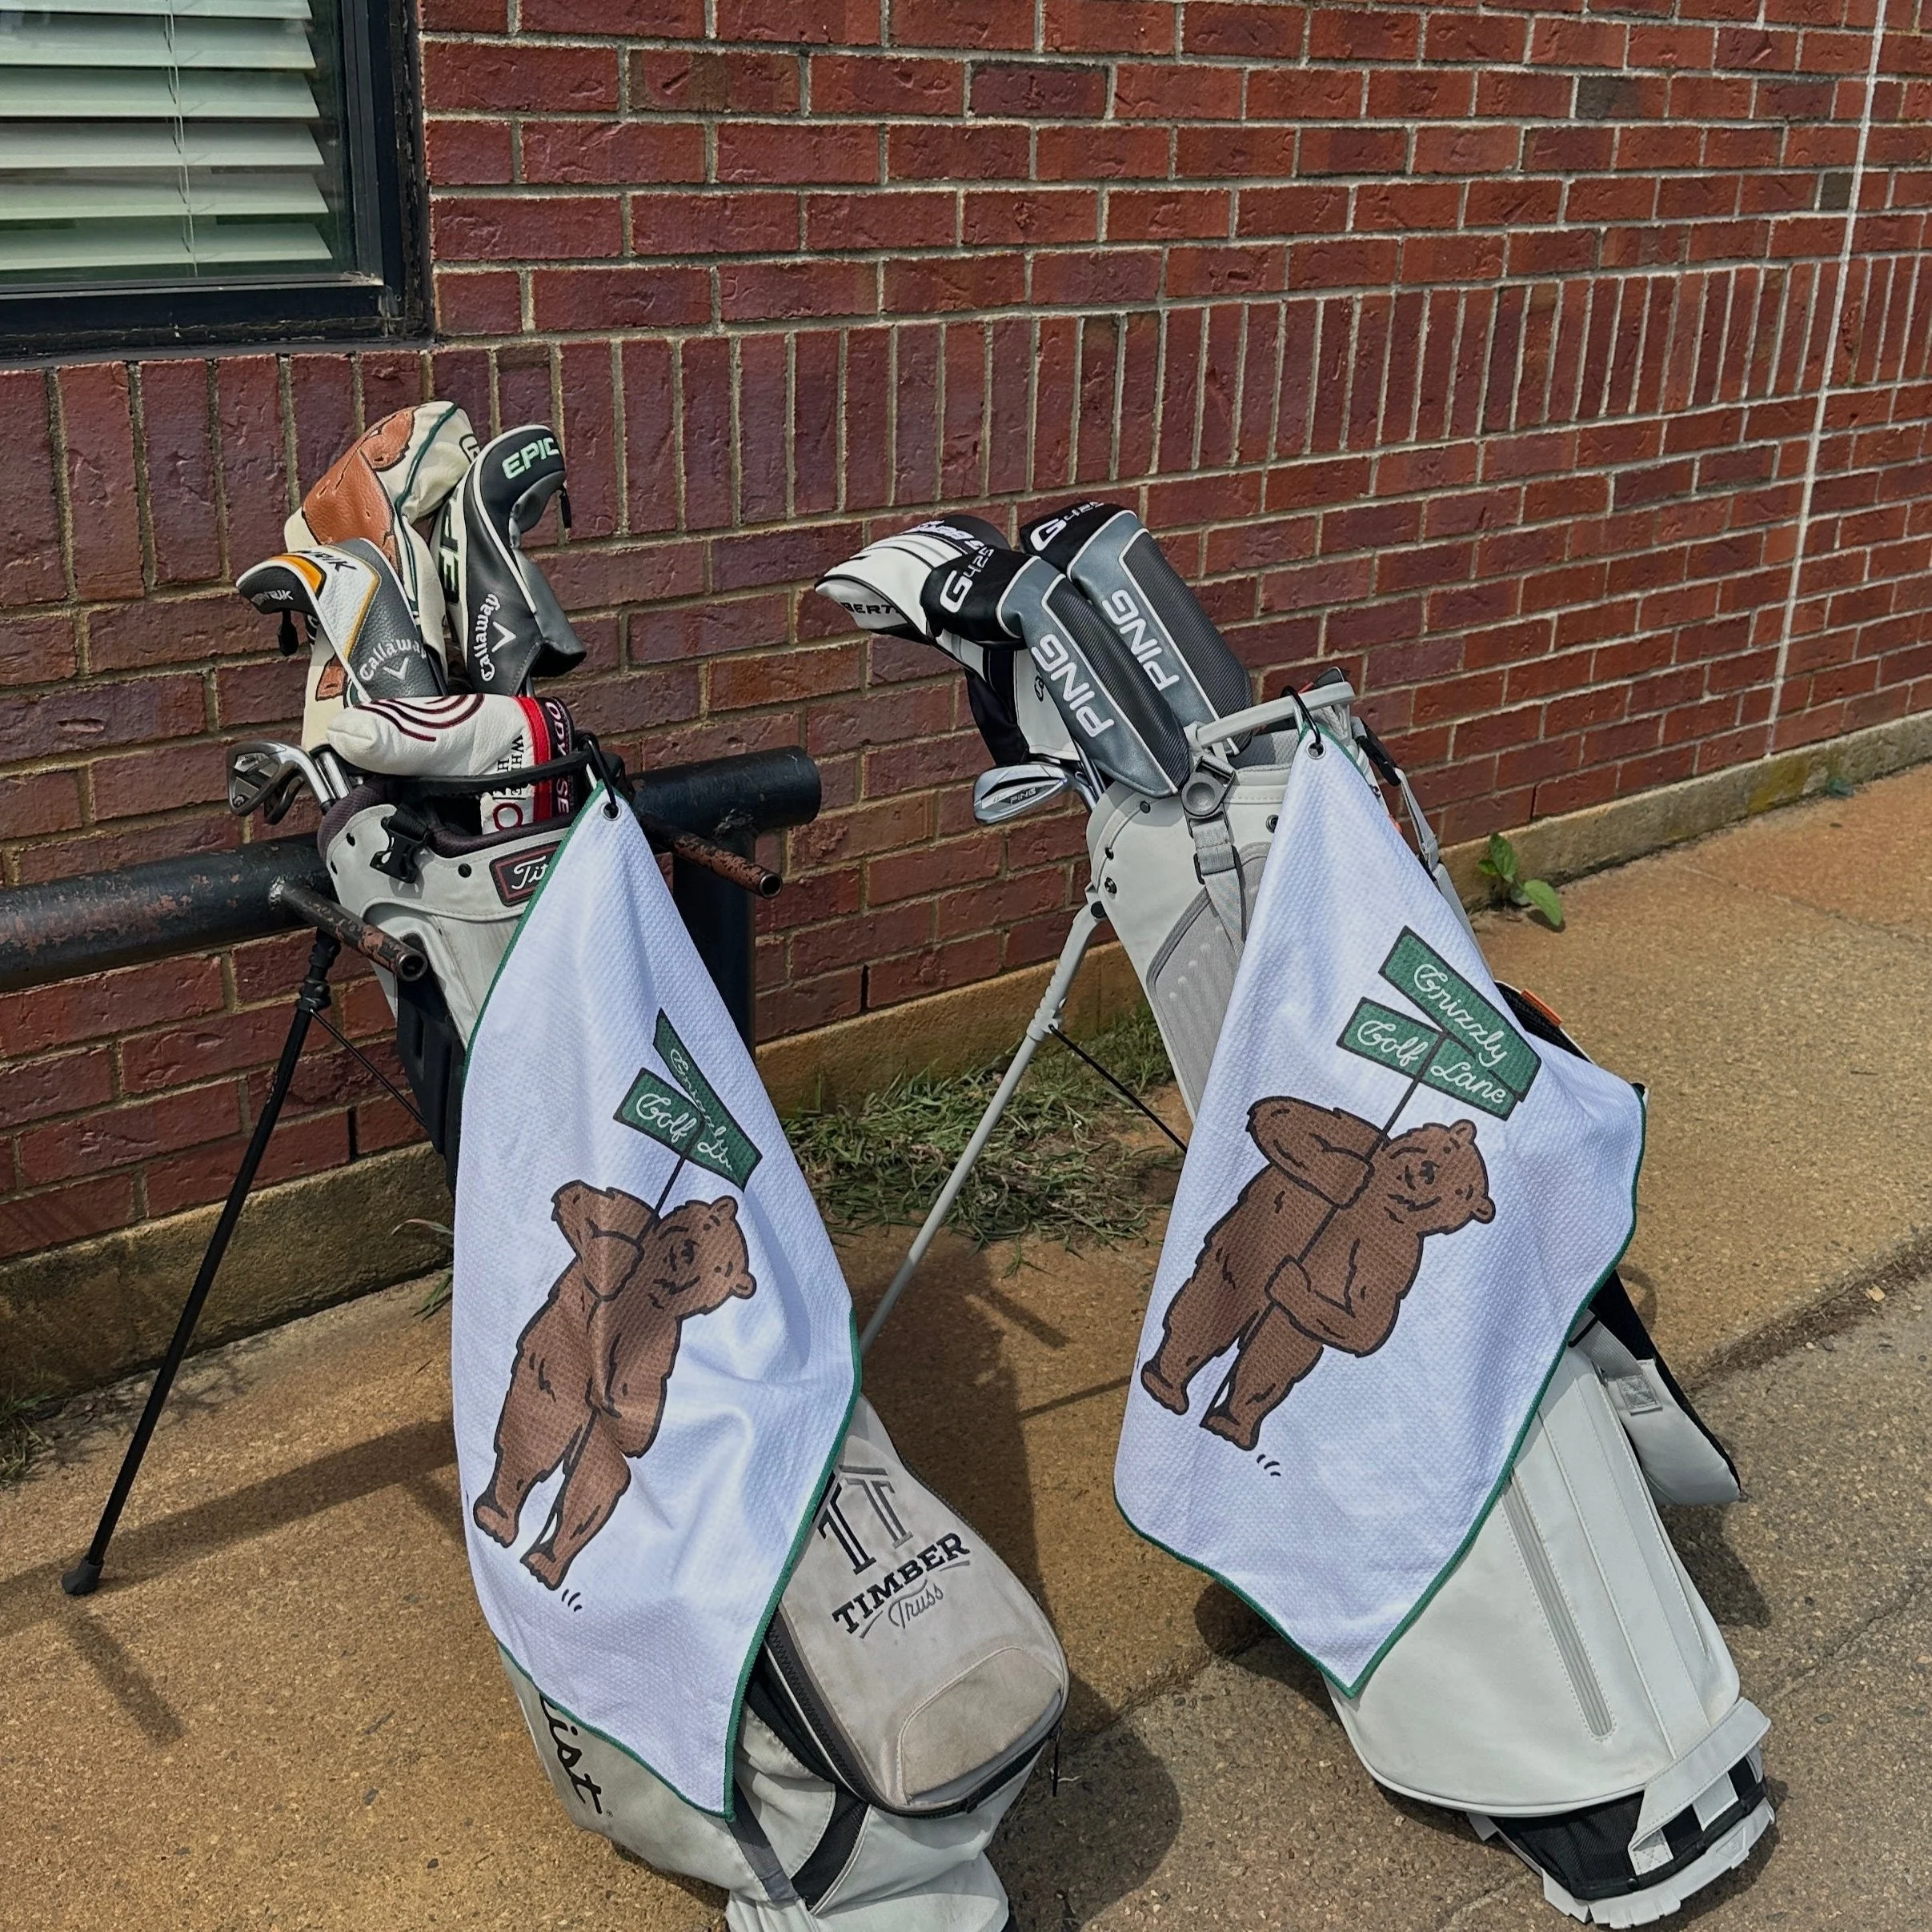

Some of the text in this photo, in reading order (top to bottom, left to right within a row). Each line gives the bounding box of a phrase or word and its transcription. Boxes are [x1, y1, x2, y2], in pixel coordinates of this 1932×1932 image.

[501, 437, 560, 480] EPIC
[840, 601, 900, 615] BERT
[940, 548, 995, 614] G425
[474, 592, 501, 682] Callaway
[1101, 589, 1180, 691] PING
[1031, 633, 1115, 738] PING
[1009, 787, 1037, 805] PING
[1413, 964, 1508, 1068] Grizzly
[1357, 1020, 1507, 1104] Golf Lane
[635, 1092, 697, 1143] Golf
[832, 1532, 971, 1634] TIMBER
[887, 1579, 944, 1629] Truss
